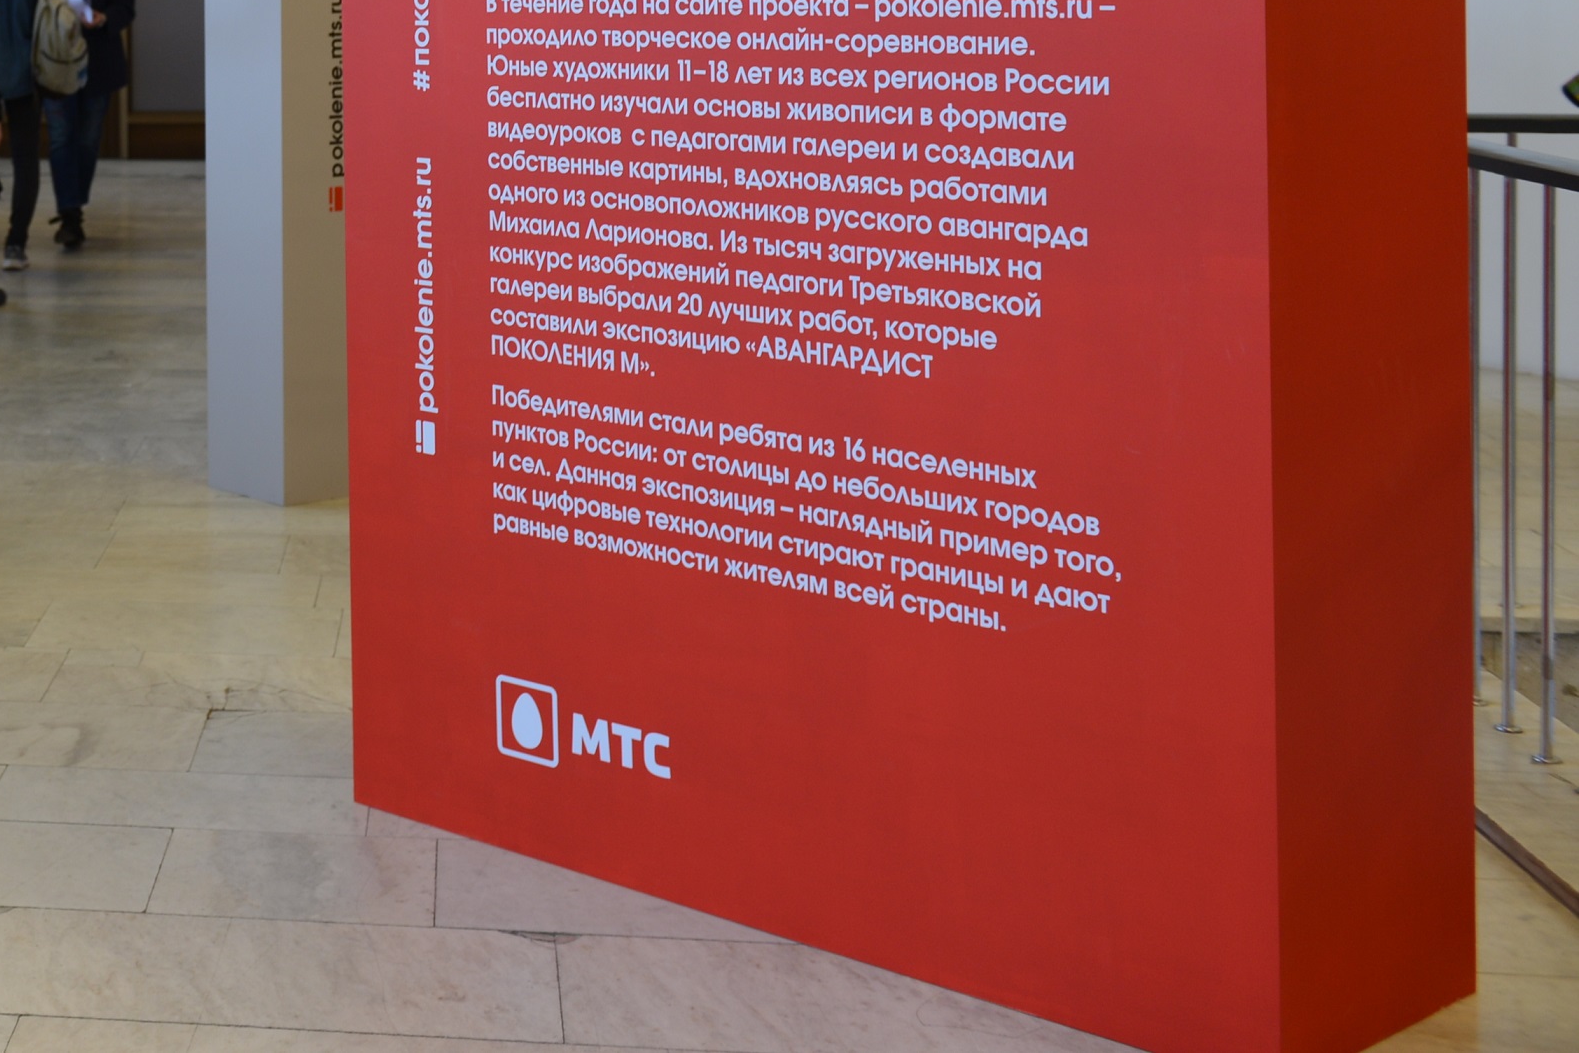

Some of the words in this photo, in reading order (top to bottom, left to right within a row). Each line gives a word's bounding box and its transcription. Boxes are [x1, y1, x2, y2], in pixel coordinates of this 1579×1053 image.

[486, 27, 598, 50] проходило
[601, 29, 732, 53] творческое
[736, 27, 1036, 58] онлайн-соревнование.
[486, 54, 548, 78] Юные
[552, 60, 670, 83] художники
[677, 58, 730, 84] 11–18
[734, 65, 773, 85] лет
[778, 66, 805, 86] из
[810, 67, 868, 88] всех
[873, 69, 998, 94] регионов
[1004, 67, 1110, 96] России
[486, 85, 596, 112] бесплатно
[600, 94, 688, 118] изучали
[693, 97, 781, 120] основы
[786, 101, 913, 126] живописи
[920, 107, 934, 126] в
[939, 102, 1067, 134] формате
[487, 121, 622, 147] видеоуроков
[631, 128, 646, 147] с
[650, 129, 787, 155] педагогами
[792, 136, 896, 164] галереи
[902, 142, 918, 162] и
[924, 143, 1075, 171] создавали
[487, 149, 624, 178] собственные
[628, 160, 728, 188] картины,
[734, 167, 904, 197] вдохновляясь
[909, 175, 1047, 207] работами
[488, 183, 559, 205] одного
[563, 188, 586, 208] из
[590, 190, 810, 225] основоположников
[815, 207, 933, 235] русского
[938, 216, 1088, 250] авангарда
[489, 209, 580, 239] Михаила
[584, 217, 714, 251] Ларионова.
[720, 229, 748, 254] Из
[752, 237, 822, 261] тысяч
[827, 243, 1001, 277] загруженных
[1007, 258, 1042, 281] на
[413, 156, 438, 415] pokolenie.mts.ru
[489, 245, 573, 273] конкурс
[578, 253, 730, 286] изображений
[735, 269, 844, 298] педагоги
[848, 274, 1042, 318] Третьяковской
[490, 276, 573, 303] галереи
[577, 284, 672, 314] выбрали
[677, 291, 703, 317] 20
[707, 300, 793, 327] лучших
[798, 309, 878, 341] работ,
[885, 319, 998, 351] которые
[490, 307, 598, 337] составили
[602, 321, 741, 355] экспозицию
[745, 335, 934, 379] «АВАНГАРДИСТ
[491, 334, 615, 372] ПОКОЛЕНИЯ
[620, 350, 656, 377] М».
[491, 384, 644, 428] Победителями
[648, 412, 714, 439] стали
[719, 422, 803, 453] ребята
[808, 436, 835, 458] из
[843, 436, 866, 463] 16
[872, 445, 1037, 489] населенных
[492, 419, 570, 448] пунктов
[574, 428, 658, 463] России:
[663, 447, 688, 468] от
[691, 452, 790, 487] столицы
[794, 469, 828, 493] до
[833, 475, 979, 517] небольших
[985, 499, 1100, 536] городов
[492, 450, 505, 469] и
[508, 454, 551, 477] сел.
[555, 457, 637, 492] Данная
[641, 476, 775, 517] экспозиция
[799, 503, 933, 545] наглядный
[939, 528, 1048, 569] пример
[1053, 548, 1122, 583] того,
[492, 481, 528, 504] как
[532, 489, 642, 525] цифровые
[645, 510, 773, 551] технологии
[778, 535, 885, 572] стирают
[890, 555, 1004, 595] границы
[1011, 577, 1028, 599] и
[1034, 583, 1111, 614] дают
[493, 513, 569, 543] равные
[573, 528, 719, 574] возможности
[724, 558, 828, 596] жителям
[834, 579, 895, 610] всей
[900, 593, 1007, 632] страны.
[570, 712, 671, 780] МТС
